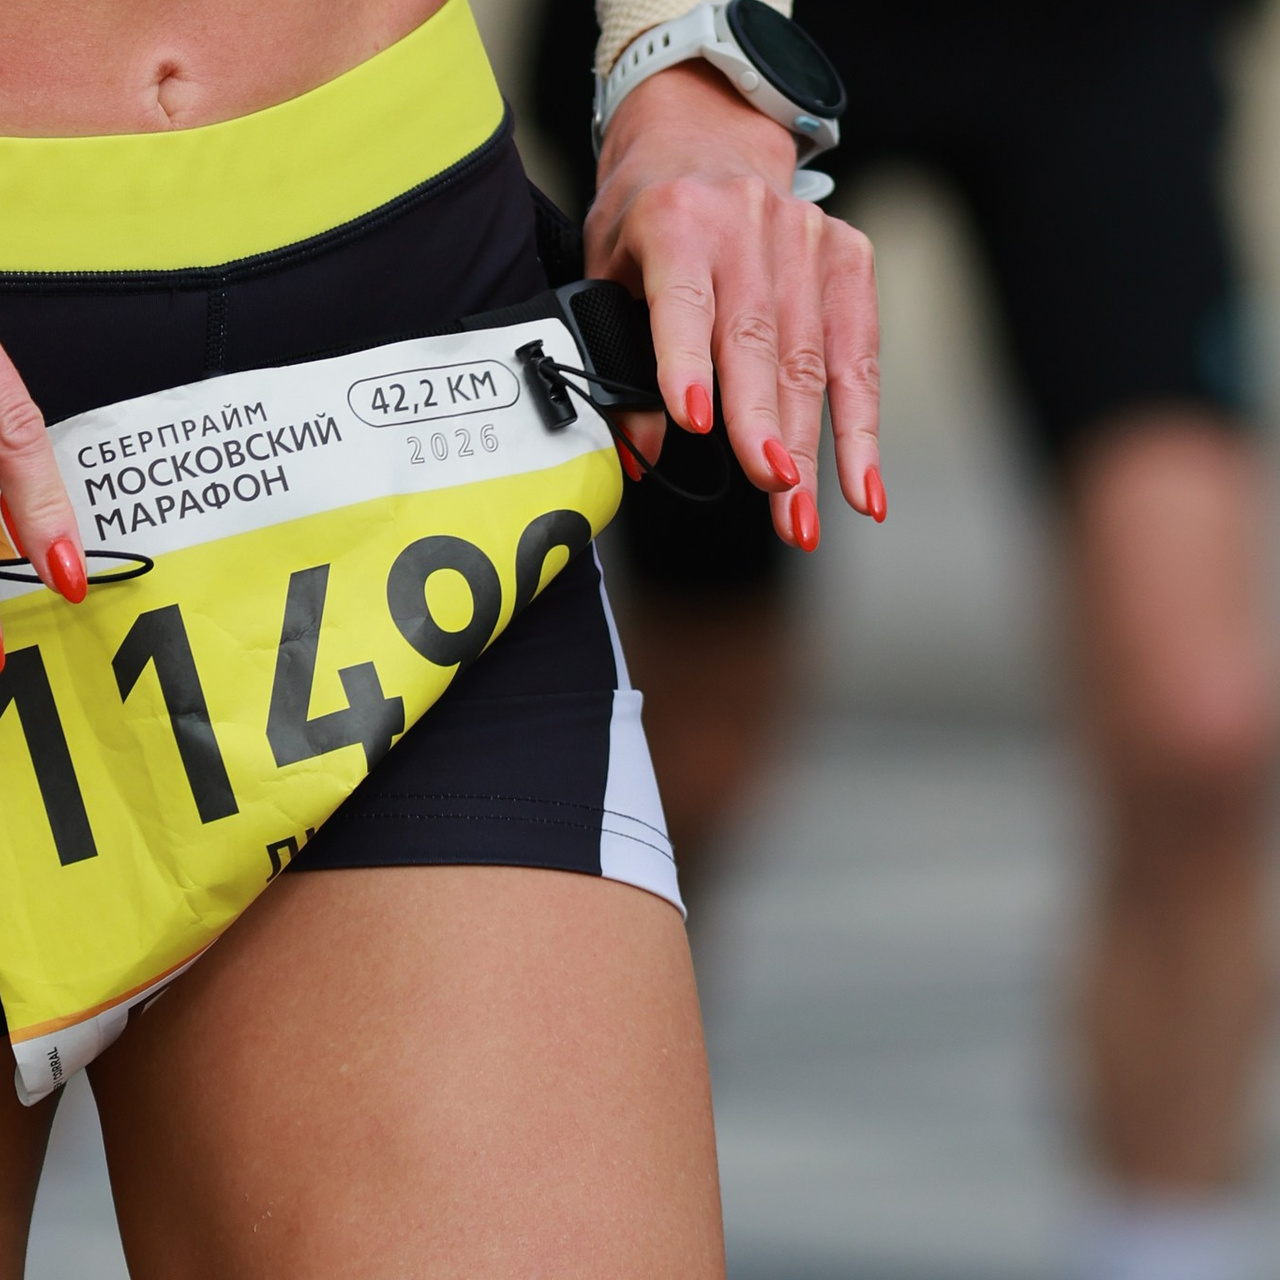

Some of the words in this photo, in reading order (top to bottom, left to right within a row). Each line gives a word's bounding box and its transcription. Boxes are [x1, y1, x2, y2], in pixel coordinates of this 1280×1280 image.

[371, 378, 438, 415] 42,2
[446, 370, 498, 404] КМ
[77, 401, 268, 469] СБЕРПРАЙМ
[84, 412, 343, 506] МОСКОВСКИЙ
[406, 423, 499, 465] 2026
[94, 464, 290, 542] МАРАФОН
